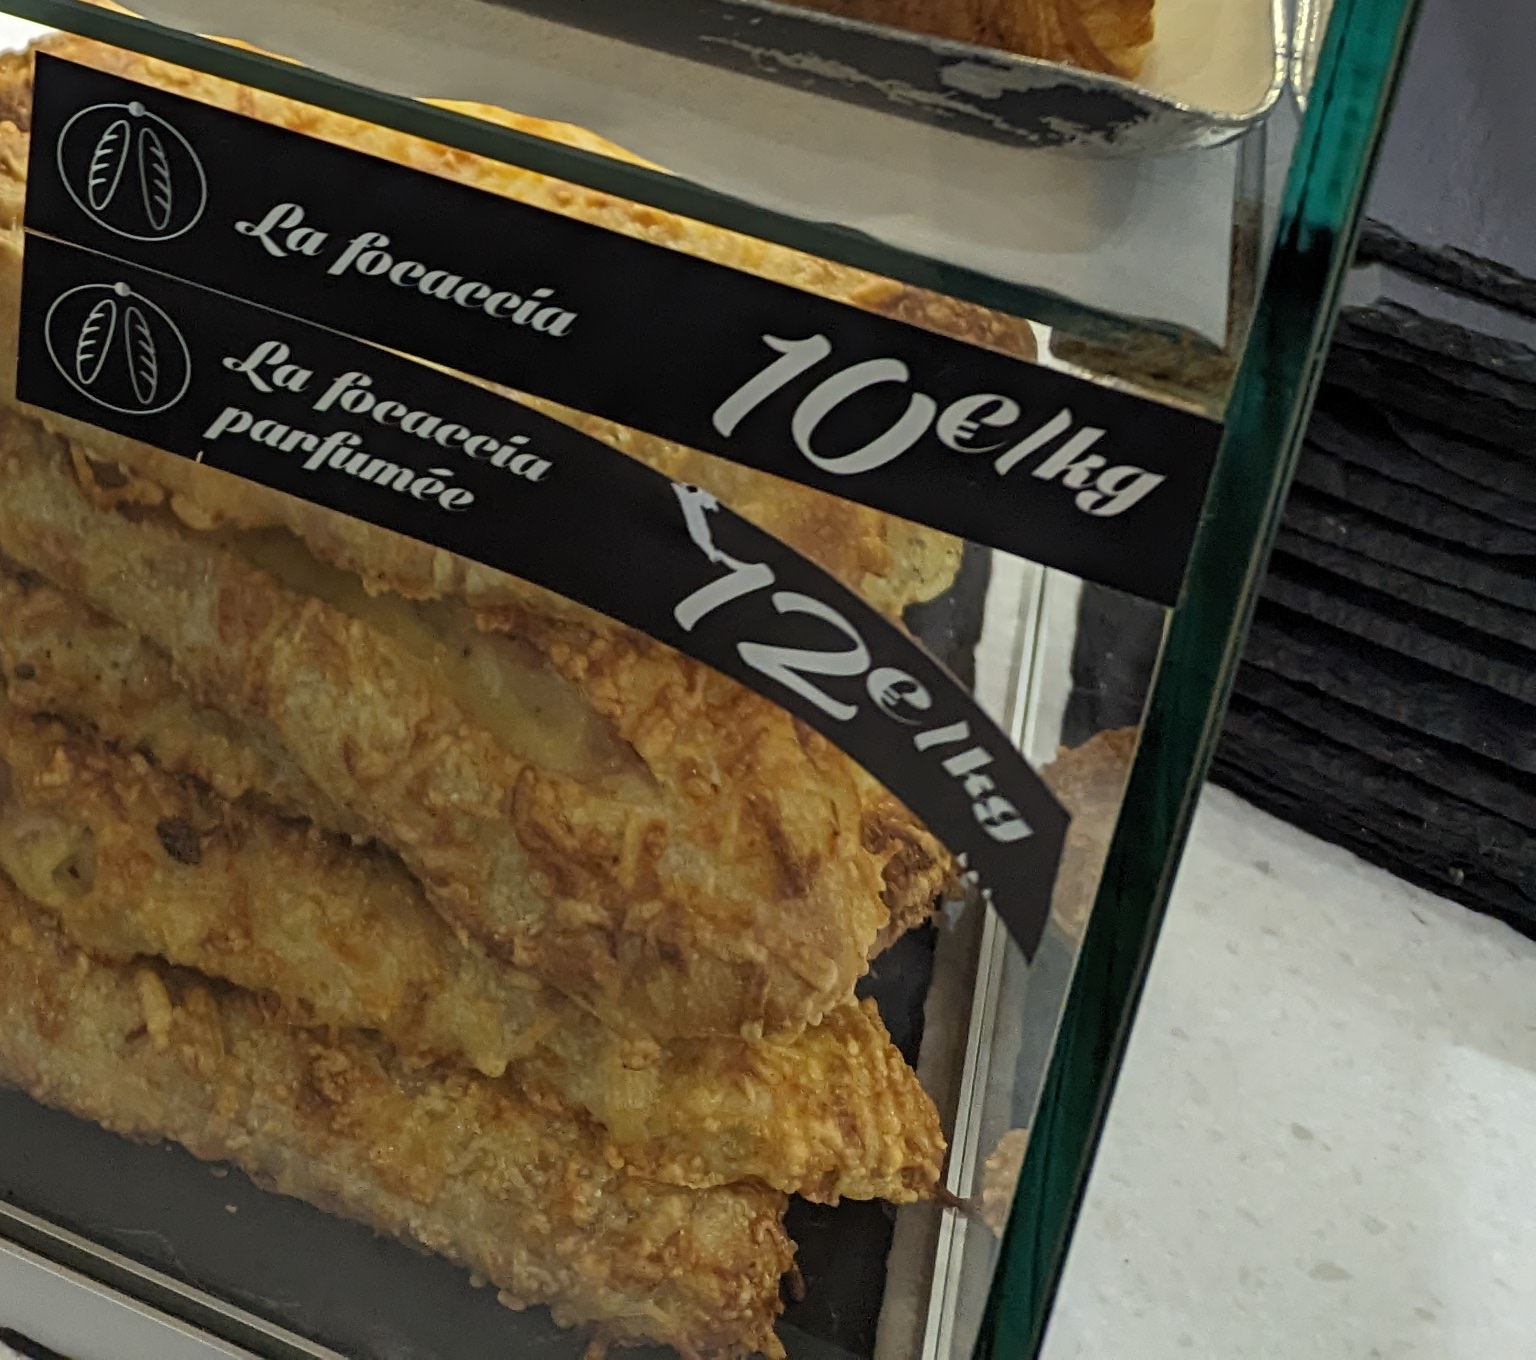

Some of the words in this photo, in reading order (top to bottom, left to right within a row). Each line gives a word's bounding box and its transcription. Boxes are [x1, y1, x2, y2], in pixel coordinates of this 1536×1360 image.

[234, 202, 330, 258] La
[327, 230, 579, 338] focaccia
[201, 405, 476, 513] parfumée
[221, 339, 314, 394] La
[312, 370, 554, 483] focaccia
